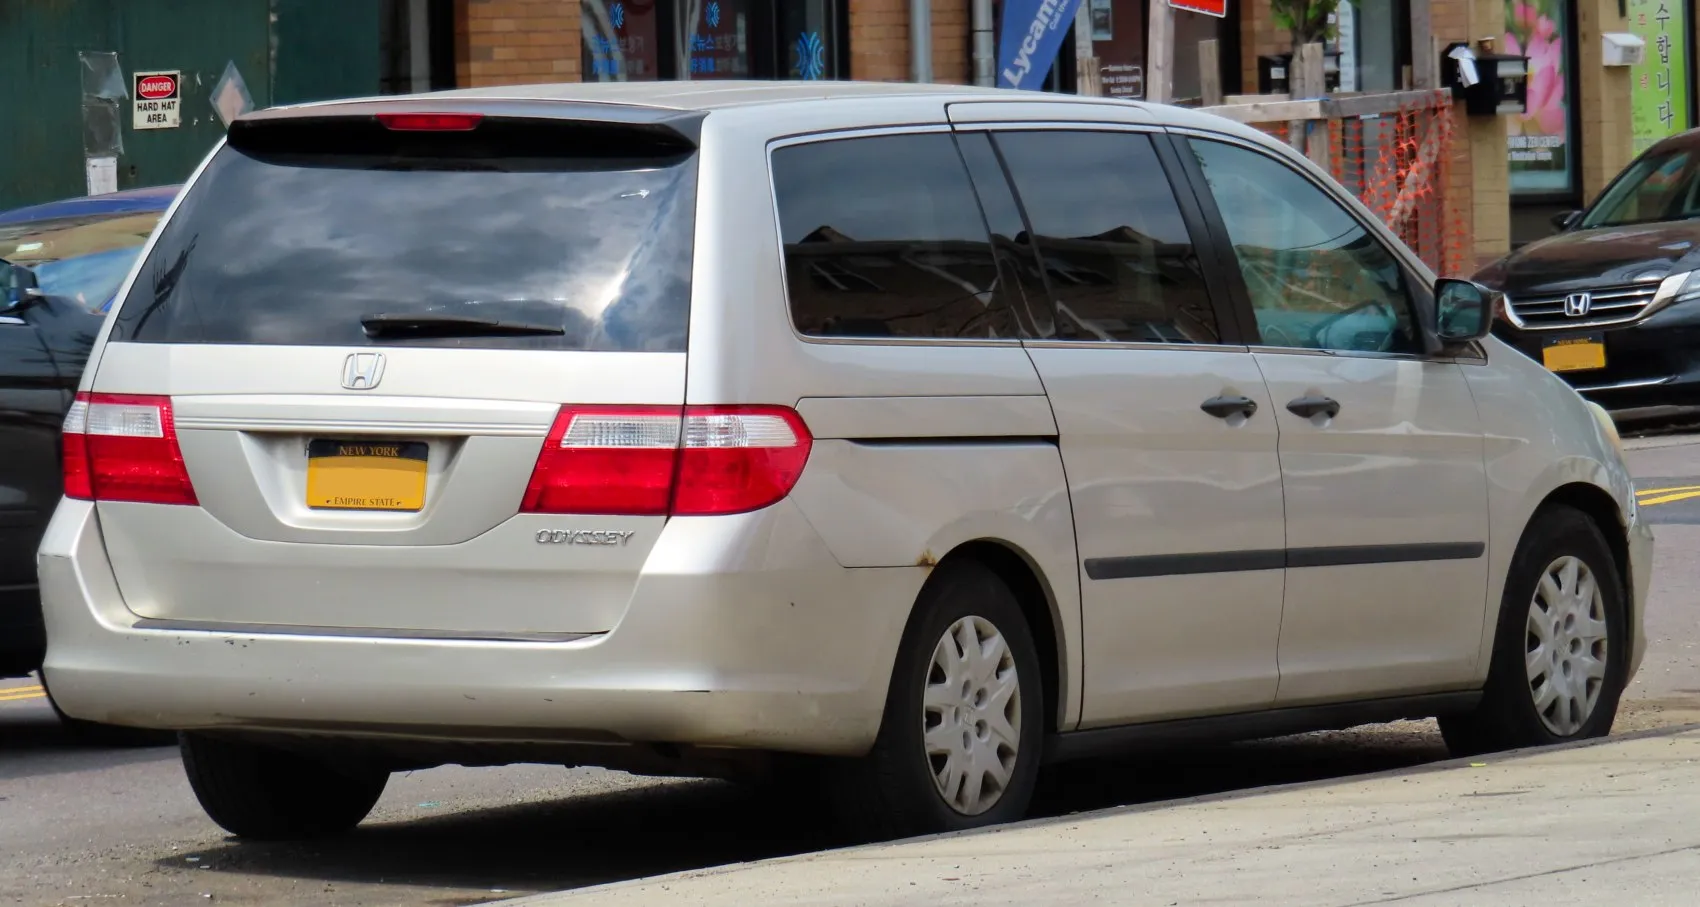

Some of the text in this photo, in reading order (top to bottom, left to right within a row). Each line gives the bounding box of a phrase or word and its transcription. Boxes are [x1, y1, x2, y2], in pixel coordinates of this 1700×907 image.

[141, 82, 171, 92] DANGER
[137, 101, 176, 112] HARD HAT
[147, 113, 167, 123] AREA
[338, 445, 399, 457] NEW YORK
[333, 496, 394, 508] EMPIRE STATE
[535, 528, 634, 546] ODYSSEY
